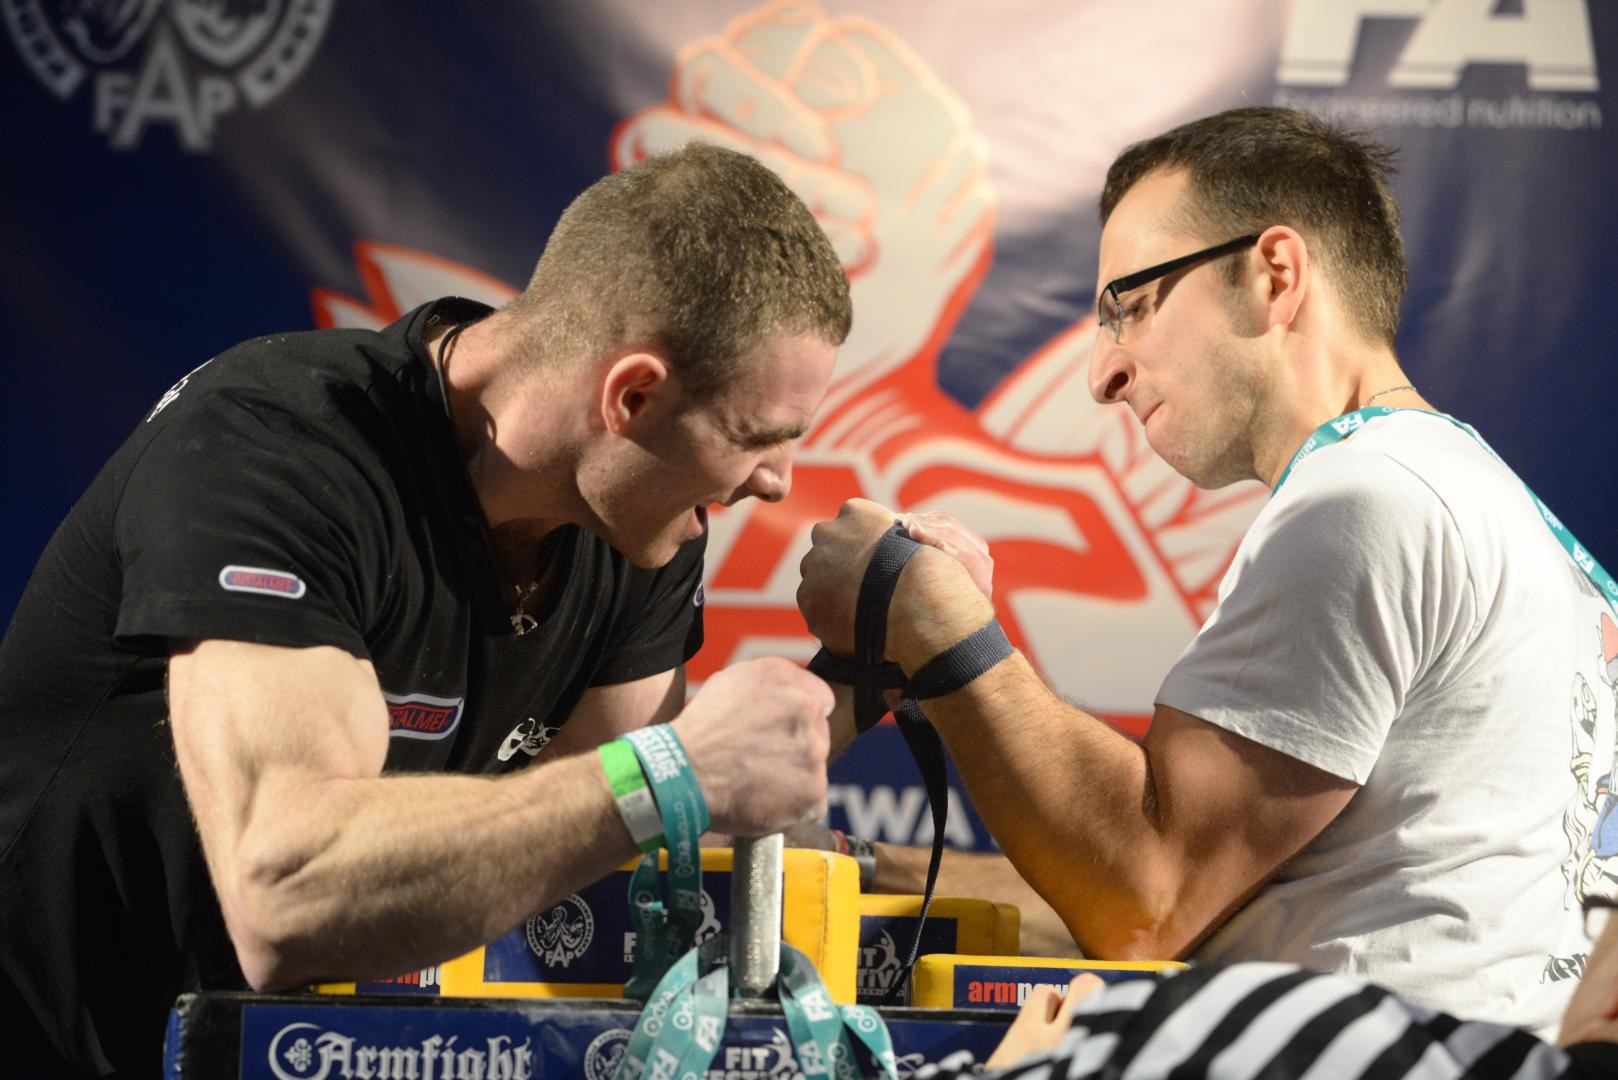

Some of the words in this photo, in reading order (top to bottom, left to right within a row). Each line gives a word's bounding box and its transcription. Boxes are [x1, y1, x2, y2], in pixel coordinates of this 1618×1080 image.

[94, 20, 240, 151] FAP
[1331, 413, 1364, 435] FA
[1573, 543, 1596, 574] FA
[545, 941, 574, 968] FAP
[800, 989, 834, 1022] FA
[694, 1015, 721, 1053] FA
[725, 1047, 769, 1069] FIT
